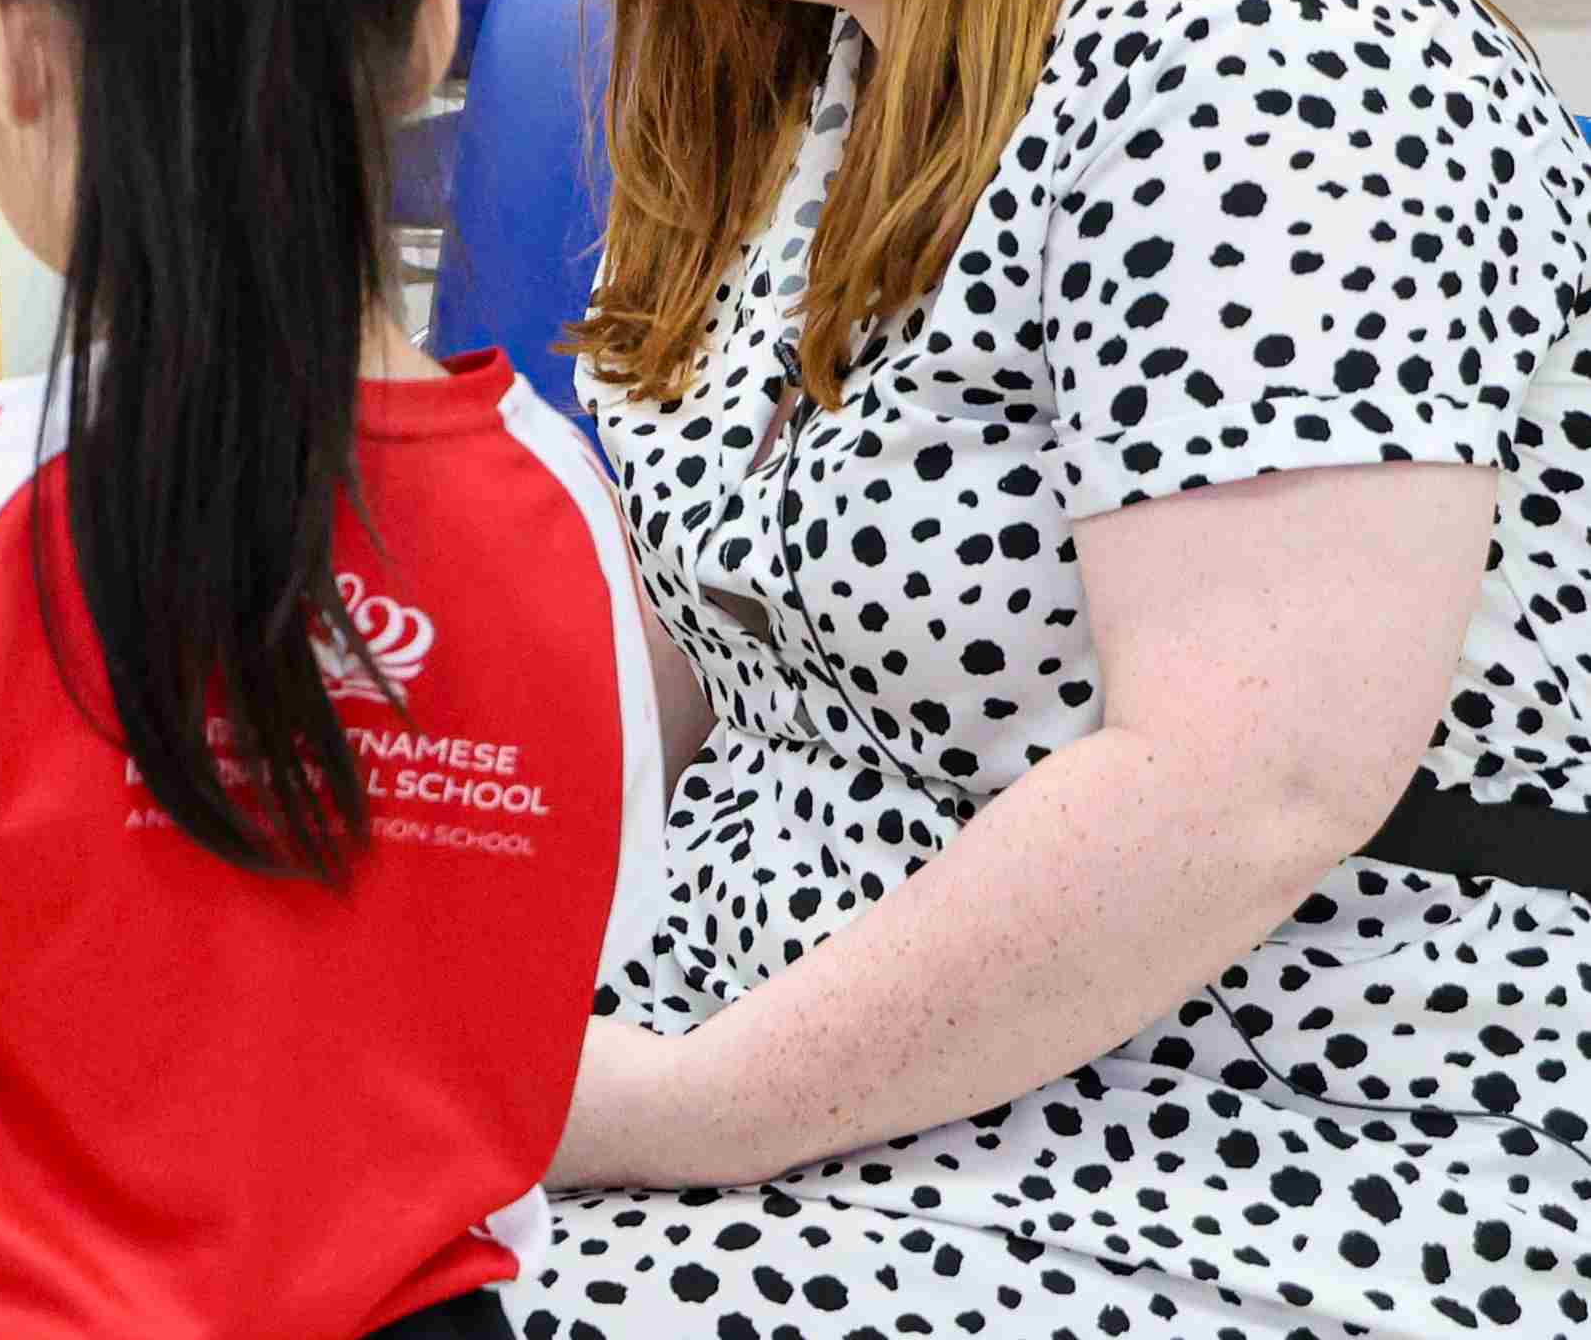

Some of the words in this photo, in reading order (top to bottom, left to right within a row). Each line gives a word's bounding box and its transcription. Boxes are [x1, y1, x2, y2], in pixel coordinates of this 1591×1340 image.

[344, 727, 519, 776] TNAMESE
[394, 769, 549, 816] SCHOOL
[432, 823, 536, 856] SCHOOL
